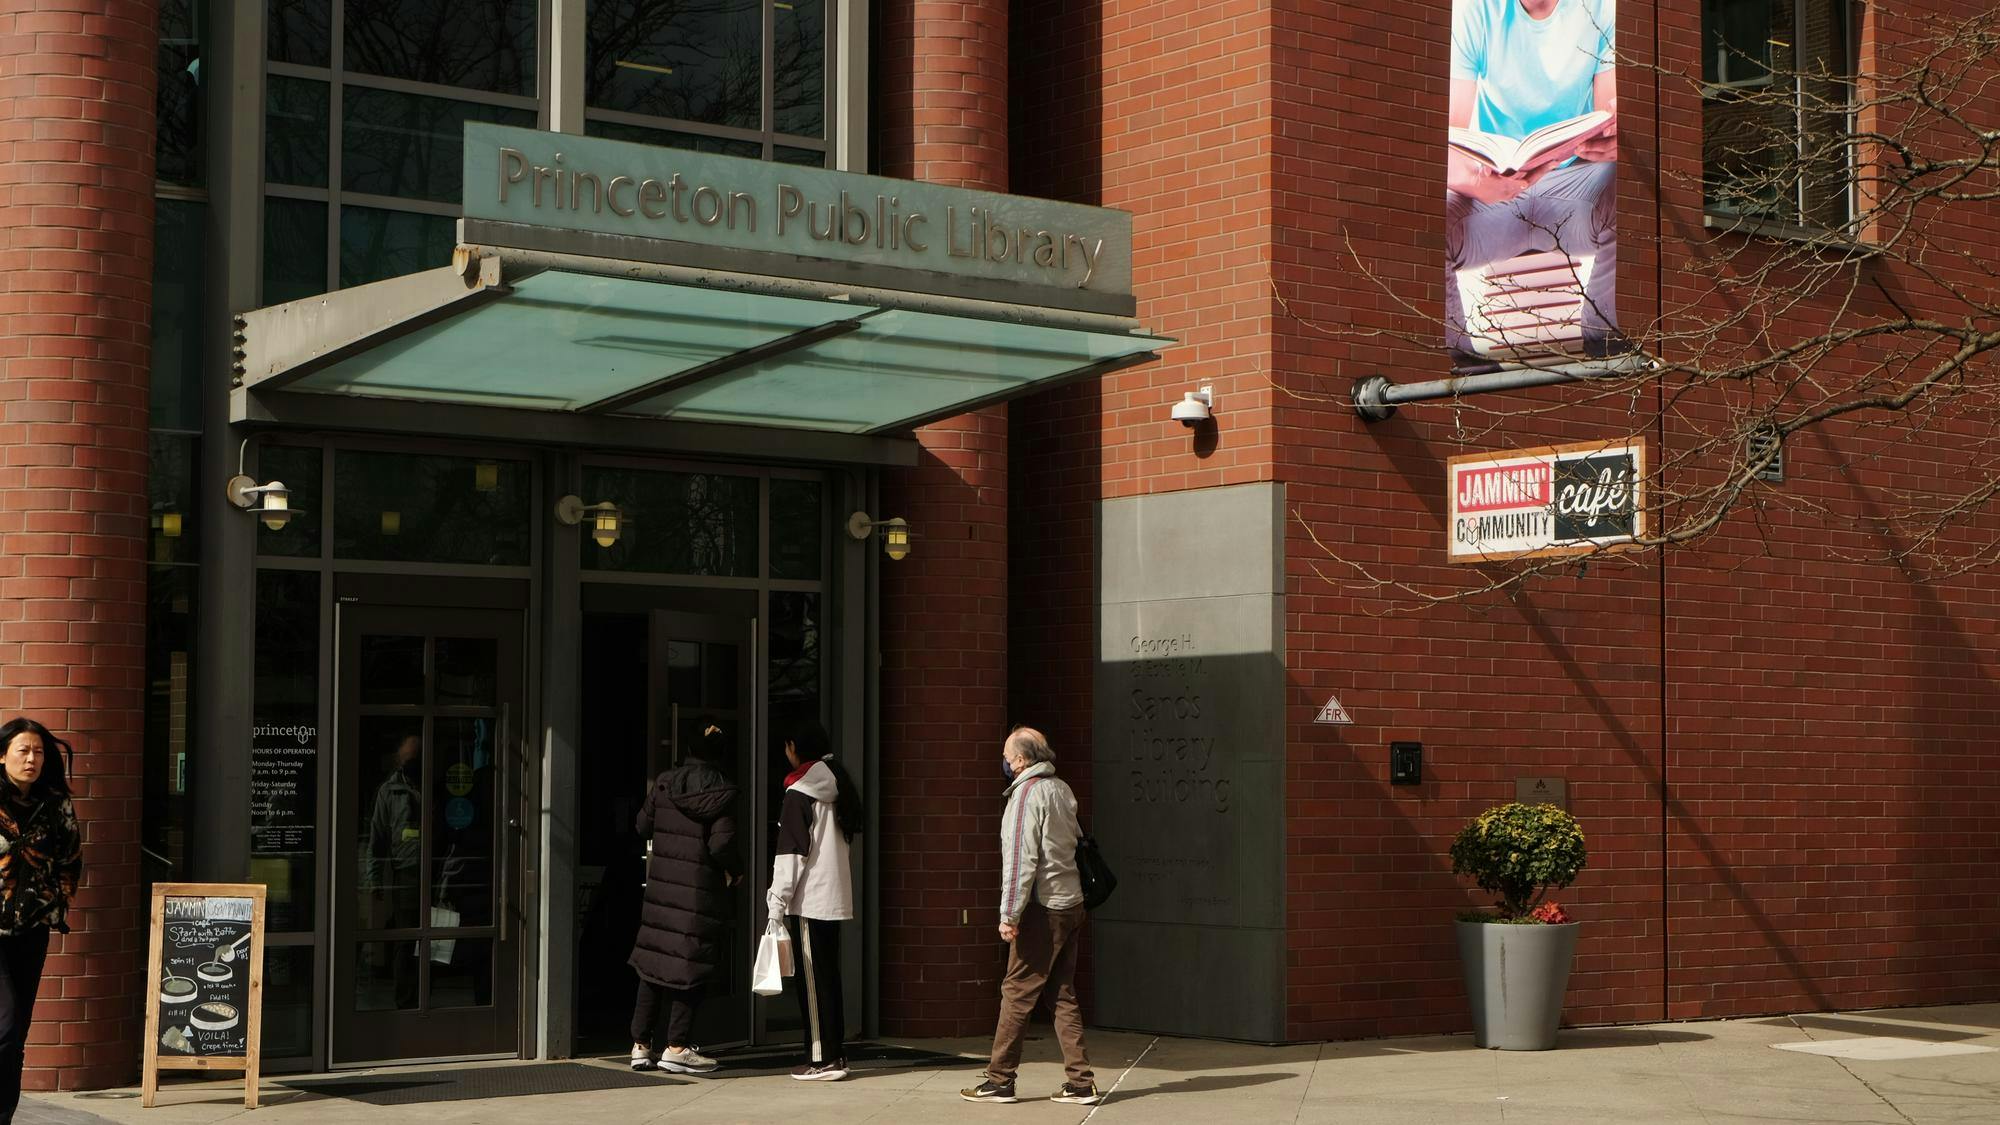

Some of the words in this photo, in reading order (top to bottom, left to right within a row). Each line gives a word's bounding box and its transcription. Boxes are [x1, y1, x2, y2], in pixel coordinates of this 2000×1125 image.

[499, 147, 757, 232] Princeton
[777, 183, 928, 252] Public
[947, 205, 1104, 289] Library
[1459, 467, 1547, 508] JAMMIN'
[1559, 467, 1629, 527] café
[1456, 511, 1549, 545] COMMUNITY
[1131, 635, 1178, 656] George
[1181, 634, 1196, 650] H.
[1131, 686, 1201, 720] Sands
[1325, 708, 1342, 721] F/R
[253, 724, 316, 744] princeton
[1131, 728, 1215, 771] Library
[251, 801, 272, 809] Sunday
[1131, 768, 1230, 814] Building
[207, 901, 252, 919] COMMUNIT
[168, 926, 197, 942] Start
[197, 928, 213, 937] with
[198, 1031, 230, 1042] VOILA!
